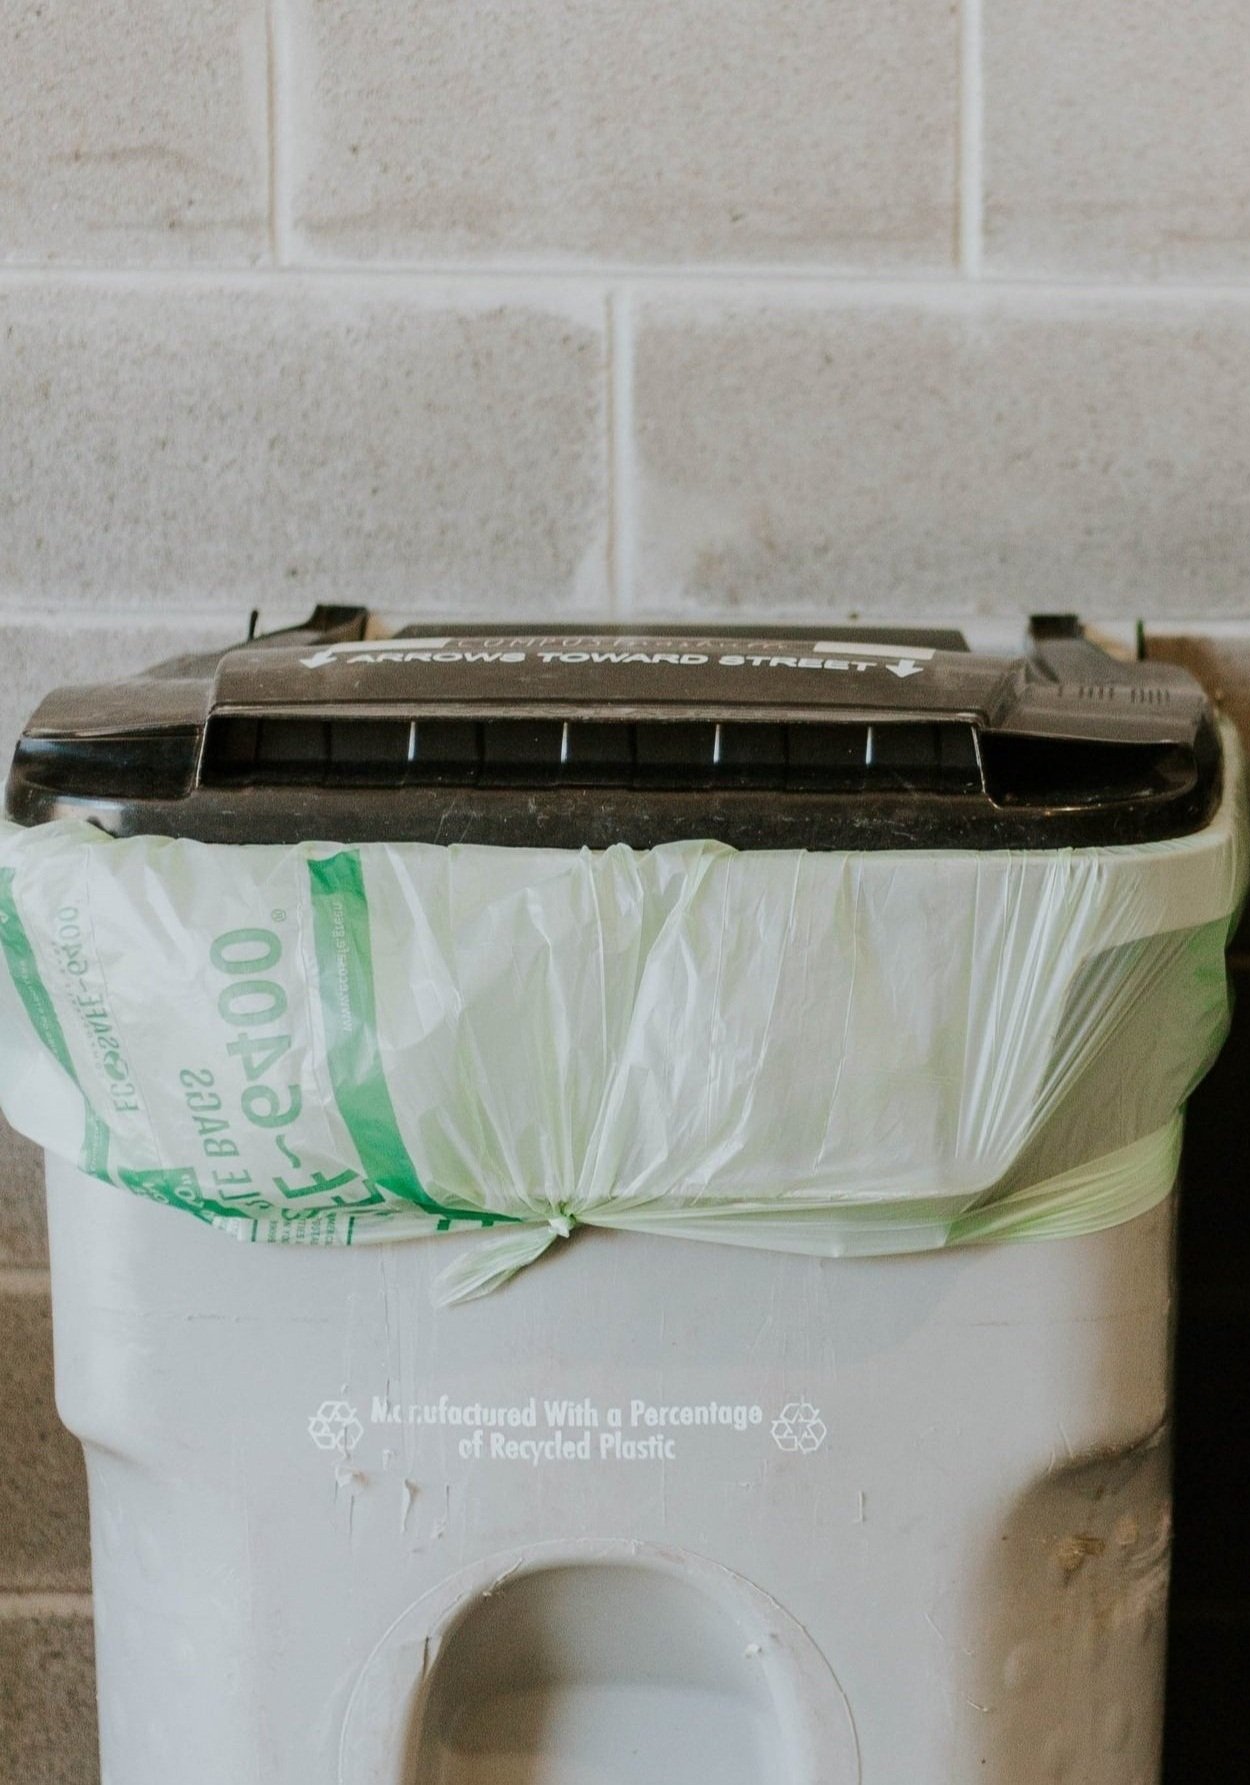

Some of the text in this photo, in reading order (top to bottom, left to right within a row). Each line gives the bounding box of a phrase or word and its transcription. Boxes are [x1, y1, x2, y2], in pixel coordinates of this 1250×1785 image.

[346, 651, 877, 672] ARROWS TOWARD STREET
[544, 1399, 599, 1428] With
[606, 1405, 623, 1428] a
[630, 1400, 763, 1432] Percentage
[458, 1430, 677, 1467] of Recycled Plastic
